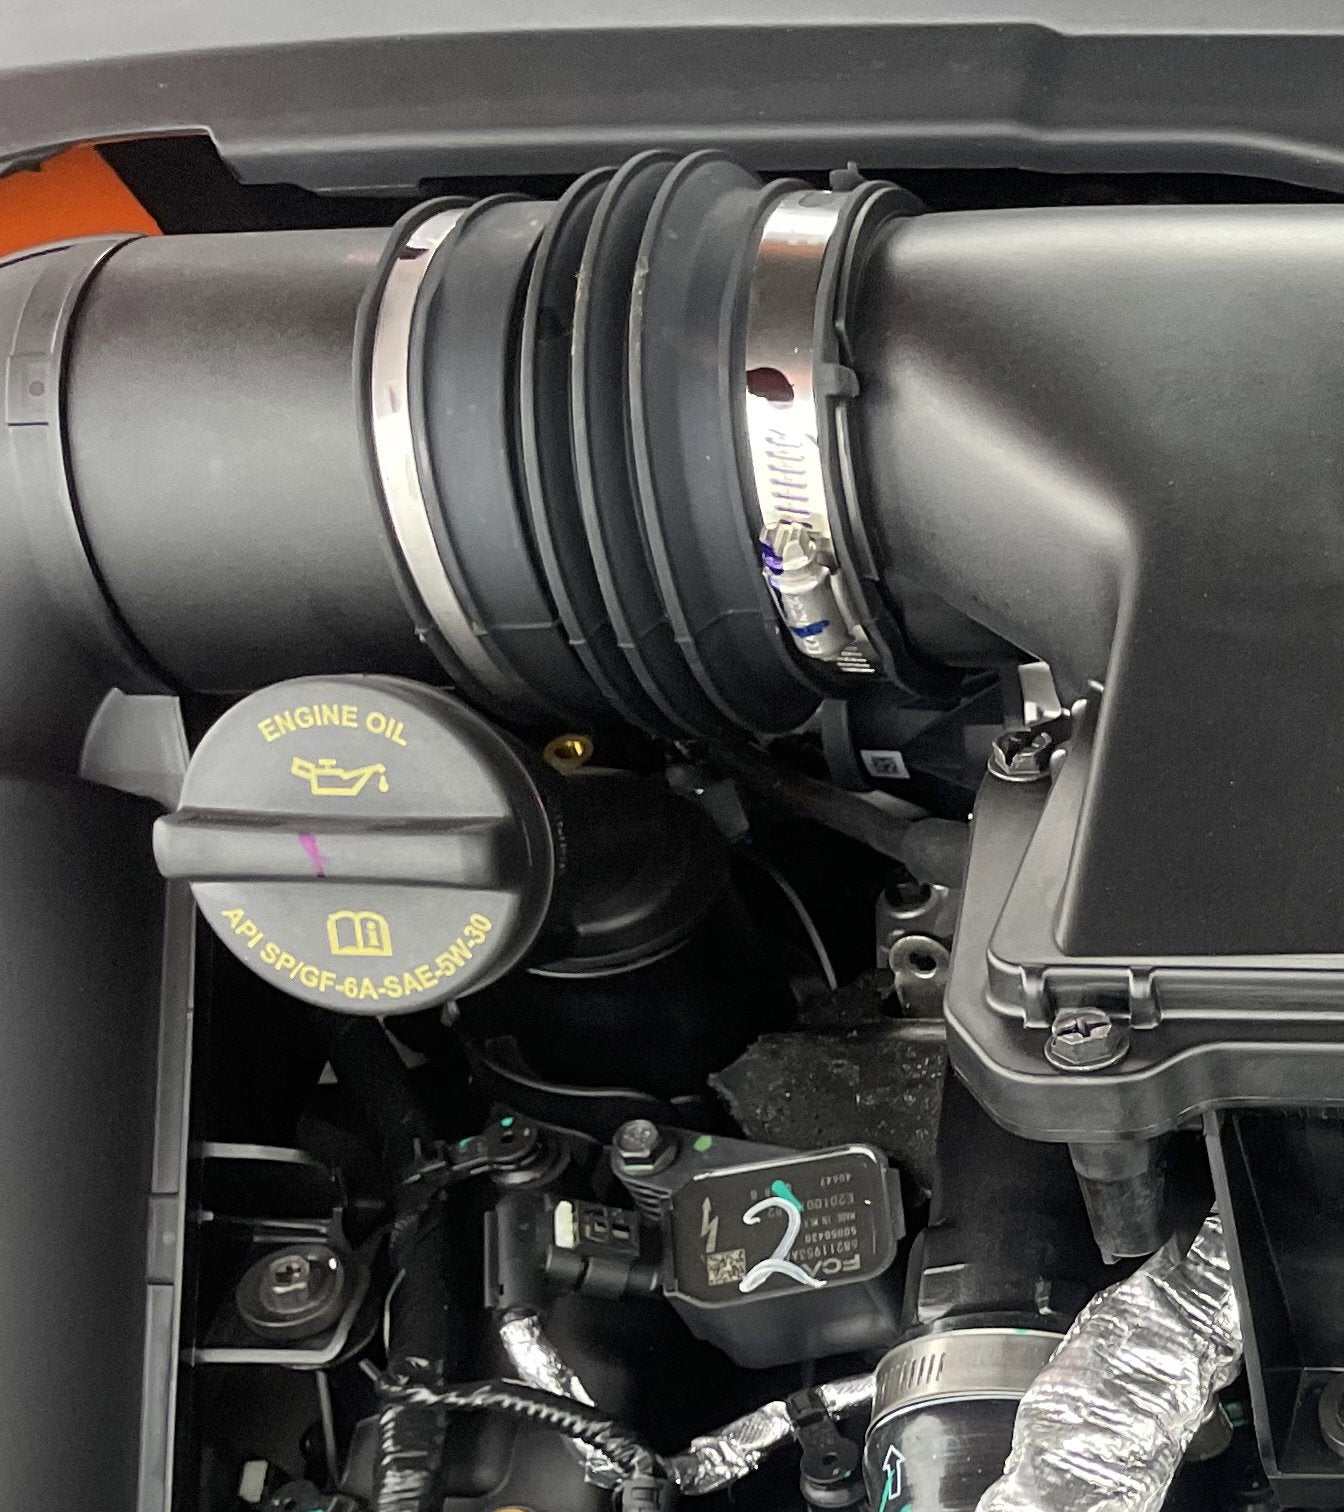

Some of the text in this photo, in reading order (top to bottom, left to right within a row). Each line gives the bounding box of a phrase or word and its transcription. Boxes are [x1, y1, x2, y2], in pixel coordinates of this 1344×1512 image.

[257, 704, 409, 747] ENGINE OIL
[222, 907, 262, 949] API
[739, 1196, 827, 1293] 2
